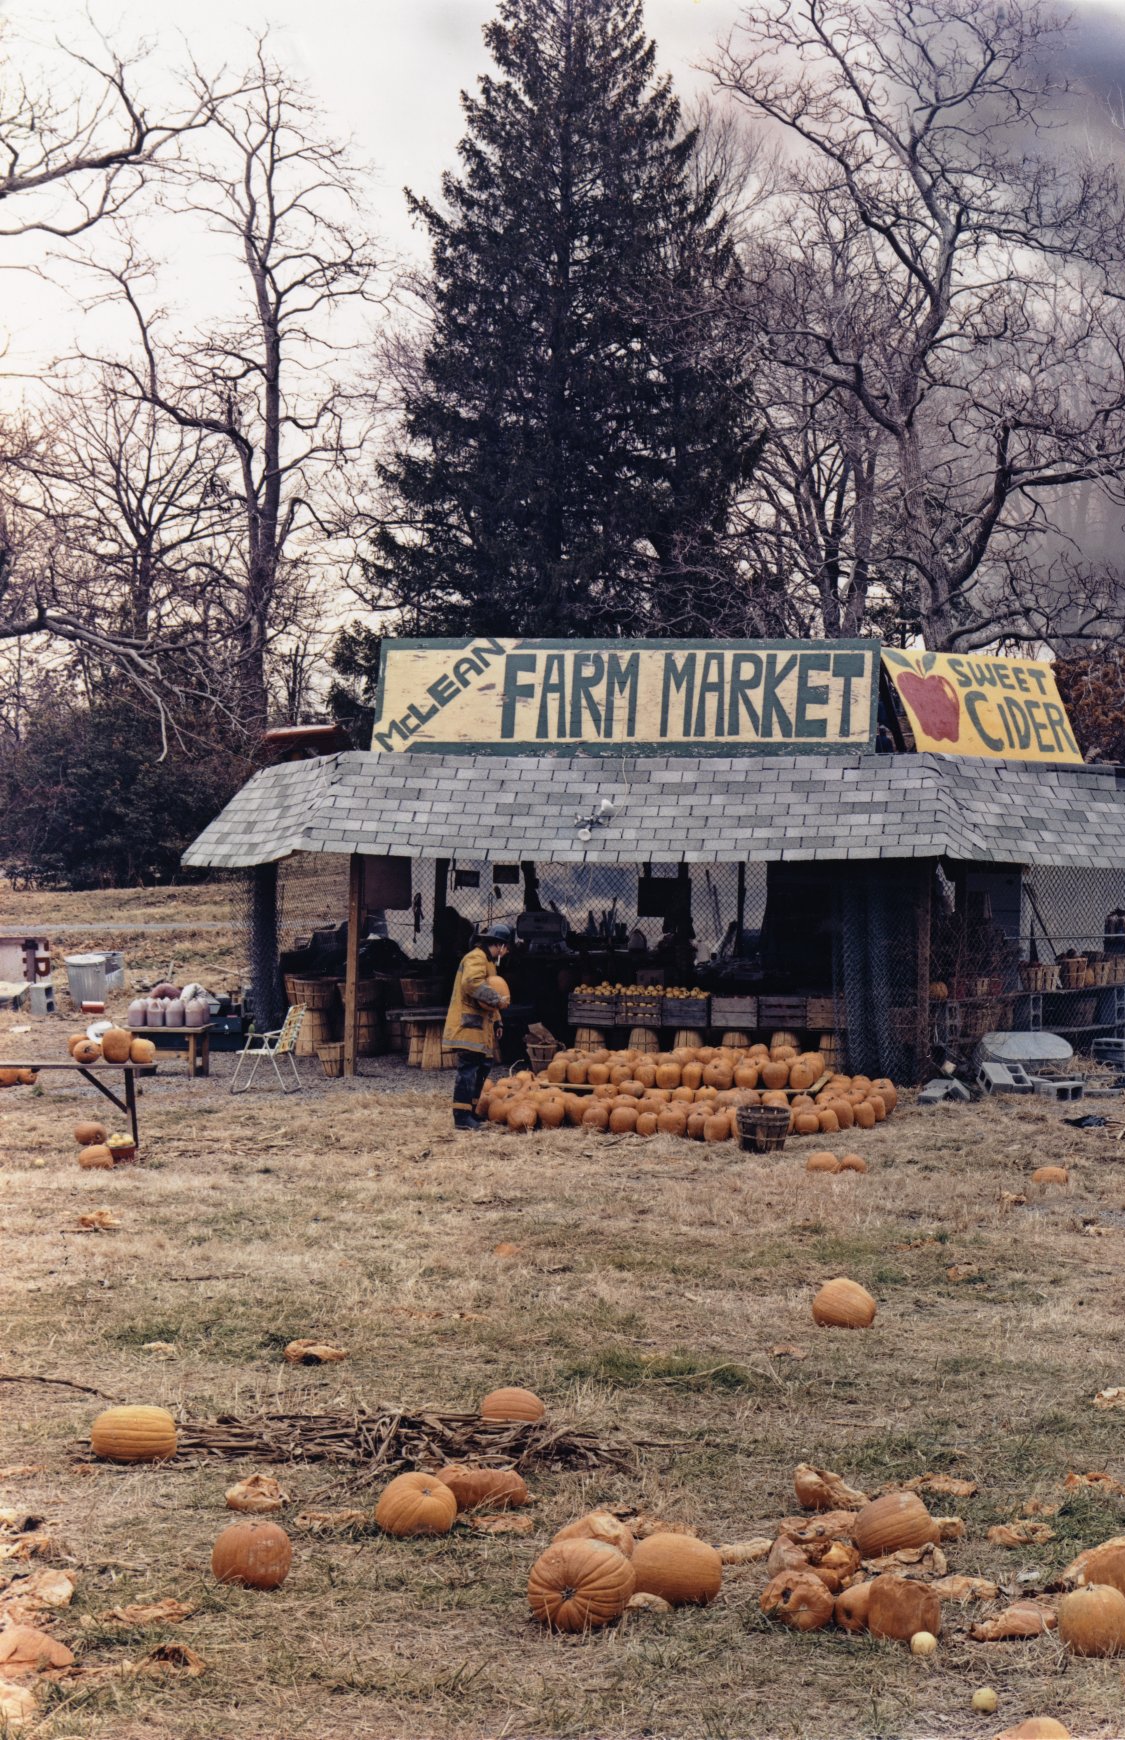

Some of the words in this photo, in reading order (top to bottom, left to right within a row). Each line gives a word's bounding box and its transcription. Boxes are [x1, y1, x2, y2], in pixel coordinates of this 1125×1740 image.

[500, 652, 640, 738] FARM
[660, 652, 865, 738] MARKET
[947, 658, 1047, 695] SWEET
[964, 690, 1079, 754] CIDER
